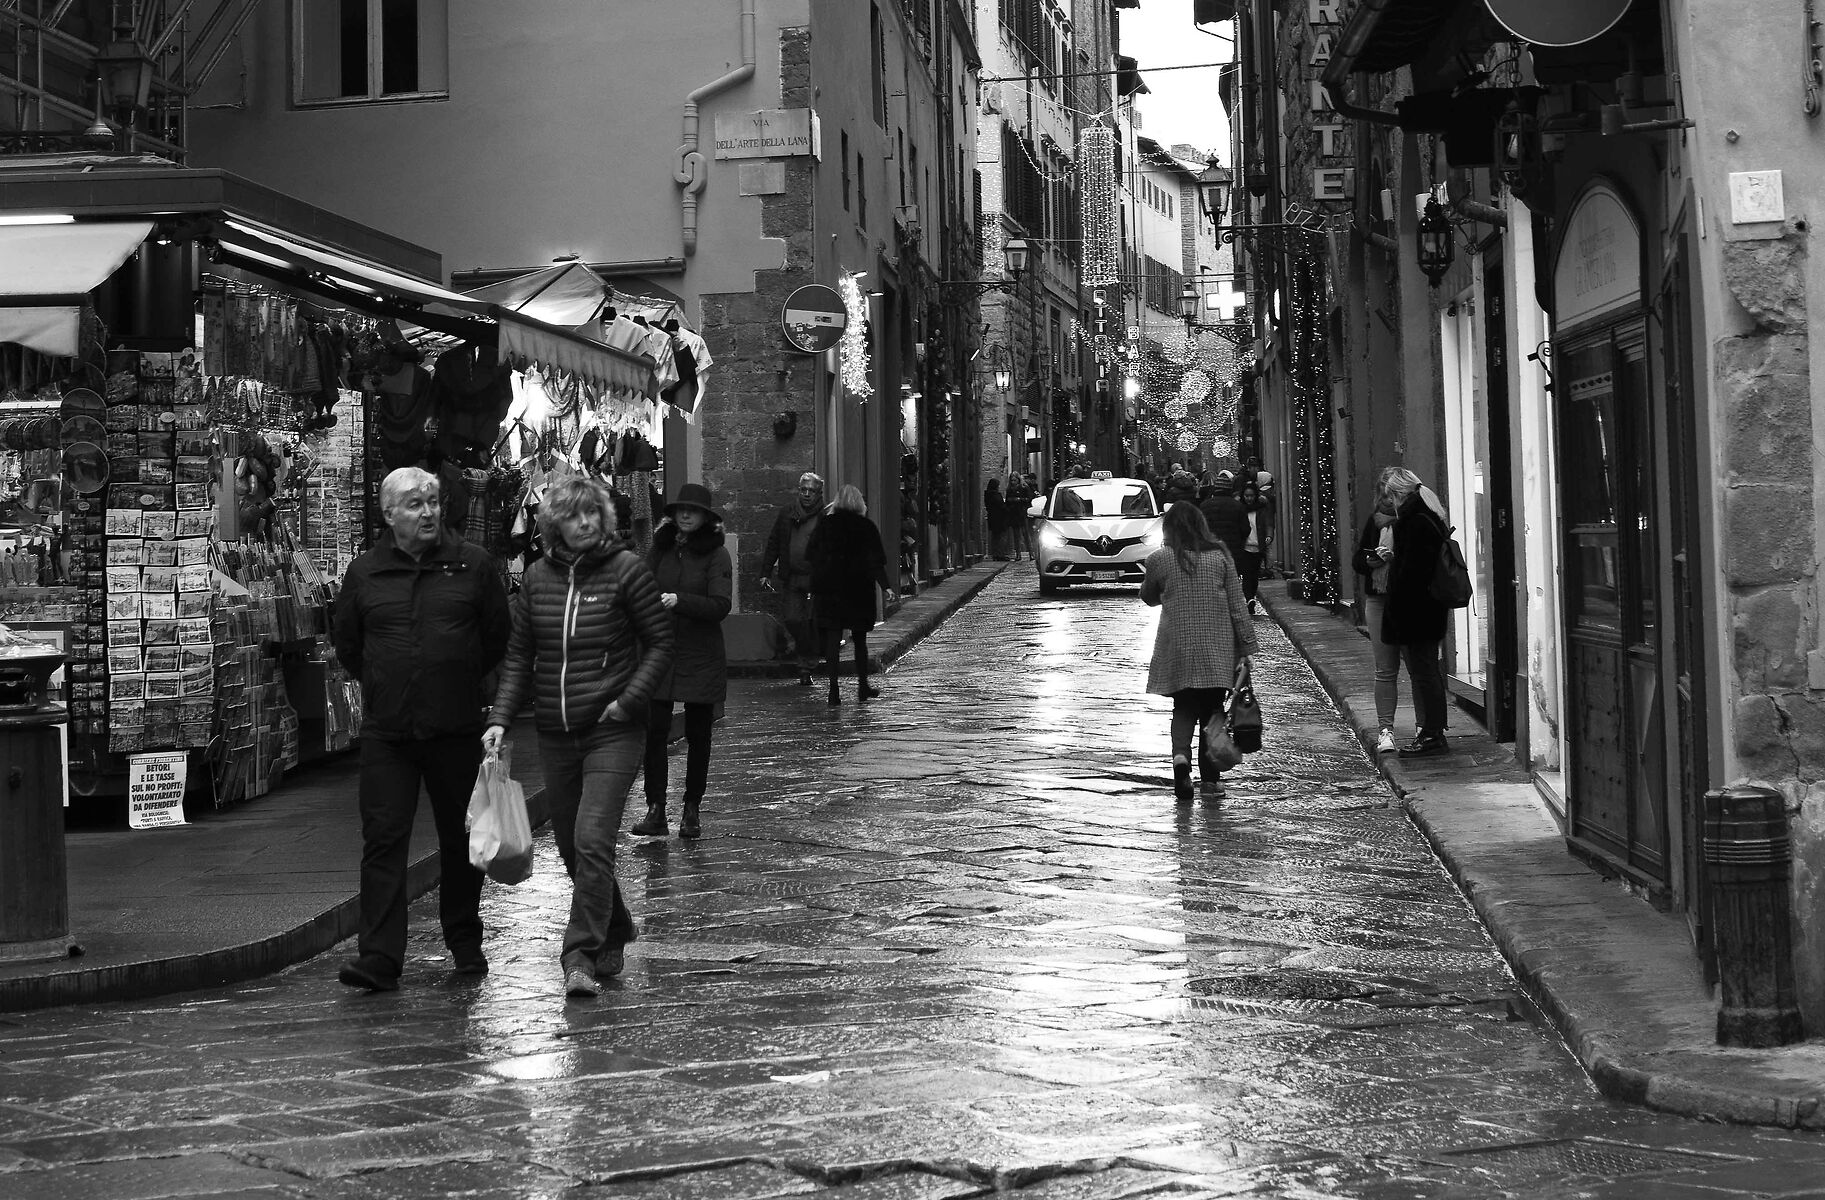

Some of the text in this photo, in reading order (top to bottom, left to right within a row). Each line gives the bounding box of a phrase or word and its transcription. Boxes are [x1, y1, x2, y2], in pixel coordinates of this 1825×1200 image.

[752, 119, 770, 128] VIA
[762, 136, 786, 147] DELLA
[788, 135, 808, 146] LANA
[1128, 326, 1140, 377] BAR
[146, 764, 170, 772] BETORI
[156, 773, 175, 781] TASSE
[158, 782, 183, 790] PROFIT:
[132, 791, 181, 802] VOLONTARIATO
[144, 800, 178, 810] DIFENDERE
